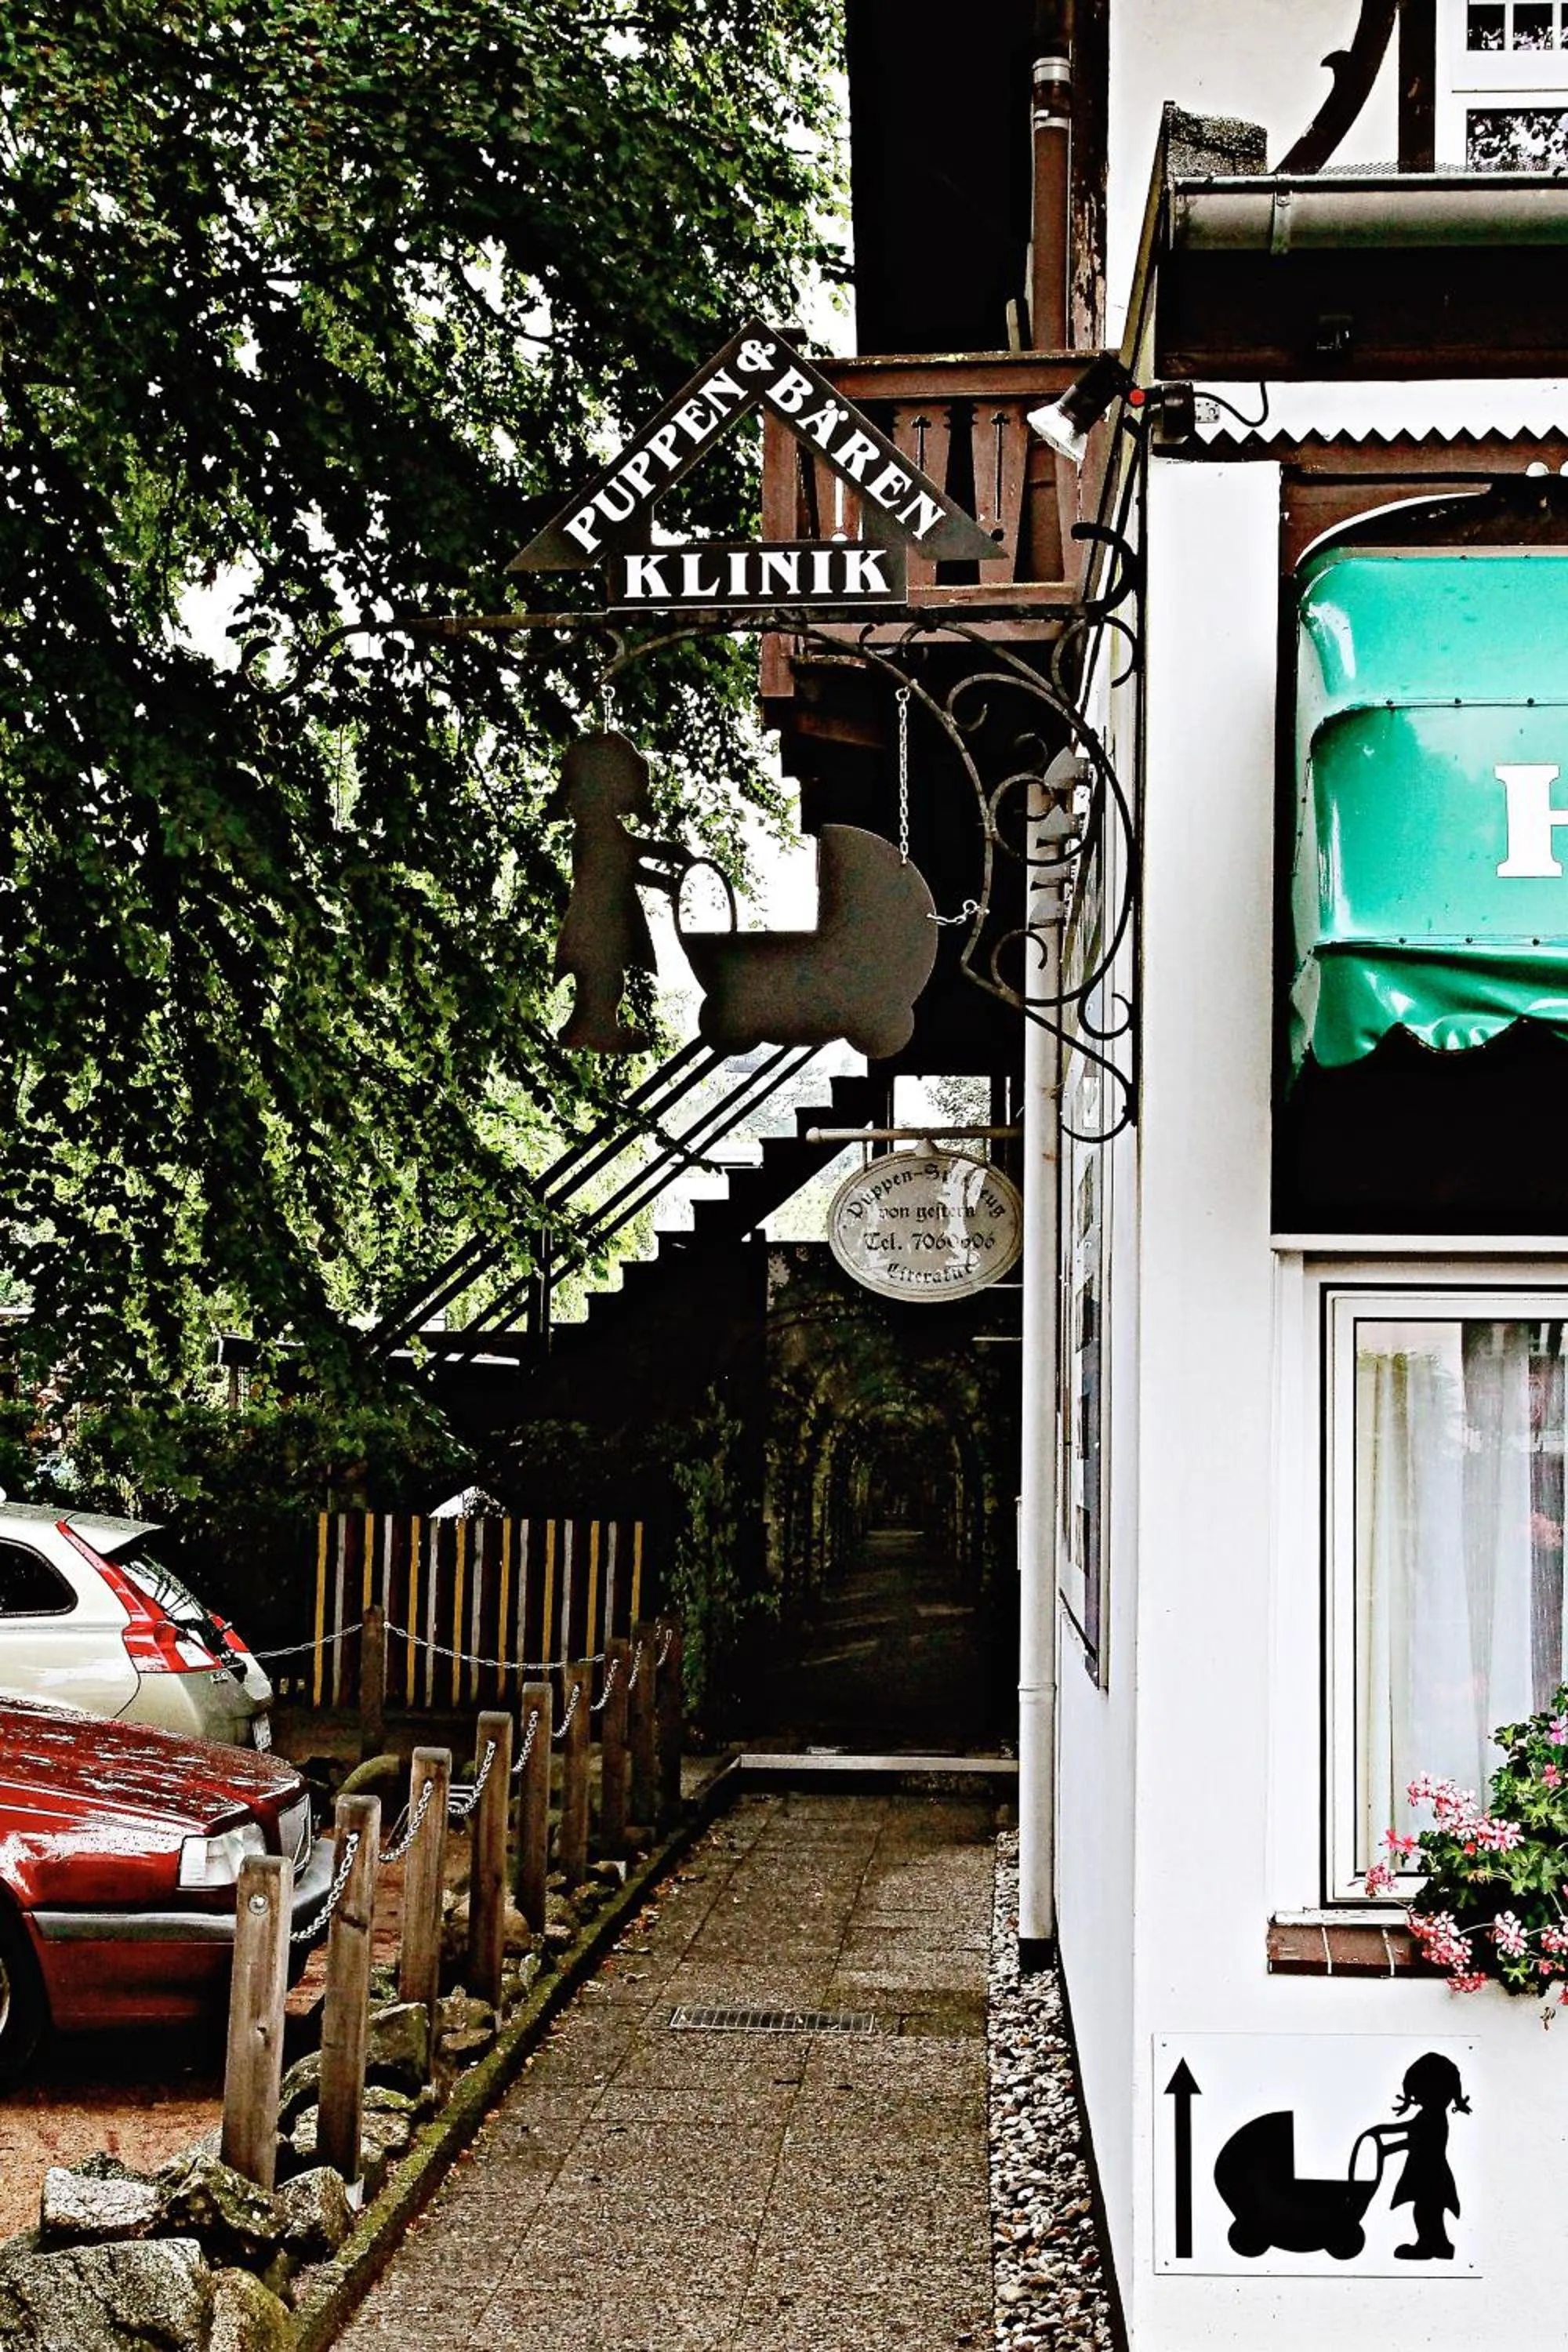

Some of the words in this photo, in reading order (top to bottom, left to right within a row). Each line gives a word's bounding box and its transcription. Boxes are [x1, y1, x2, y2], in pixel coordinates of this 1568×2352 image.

[563, 369, 749, 554] PUPPEN
[736, 339, 776, 372] &
[764, 365, 946, 541] BÄREN
[623, 550, 891, 598] KLINIK
[864, 1232, 902, 1250] Tel.
